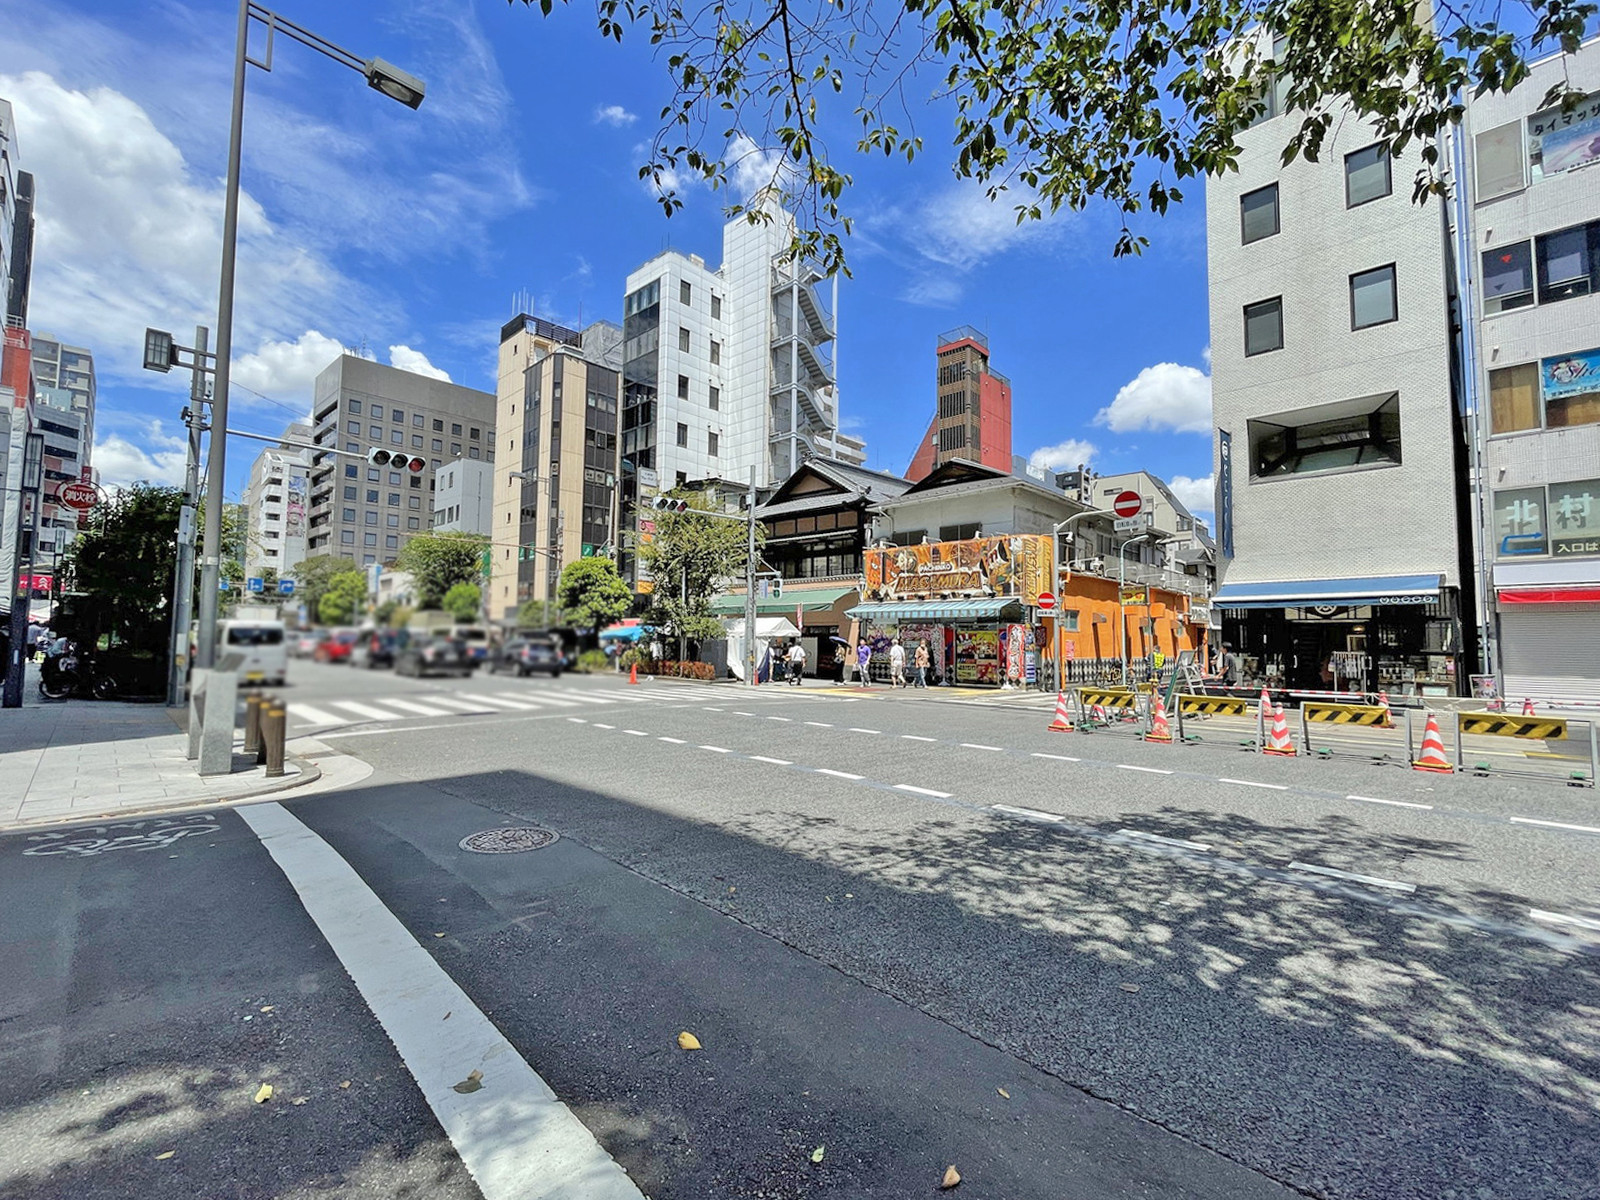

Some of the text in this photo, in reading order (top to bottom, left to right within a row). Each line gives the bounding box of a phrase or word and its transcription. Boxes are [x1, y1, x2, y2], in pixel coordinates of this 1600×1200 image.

[64, 489, 97, 504] 消火栓
[894, 571, 983, 594] MASAMURA
